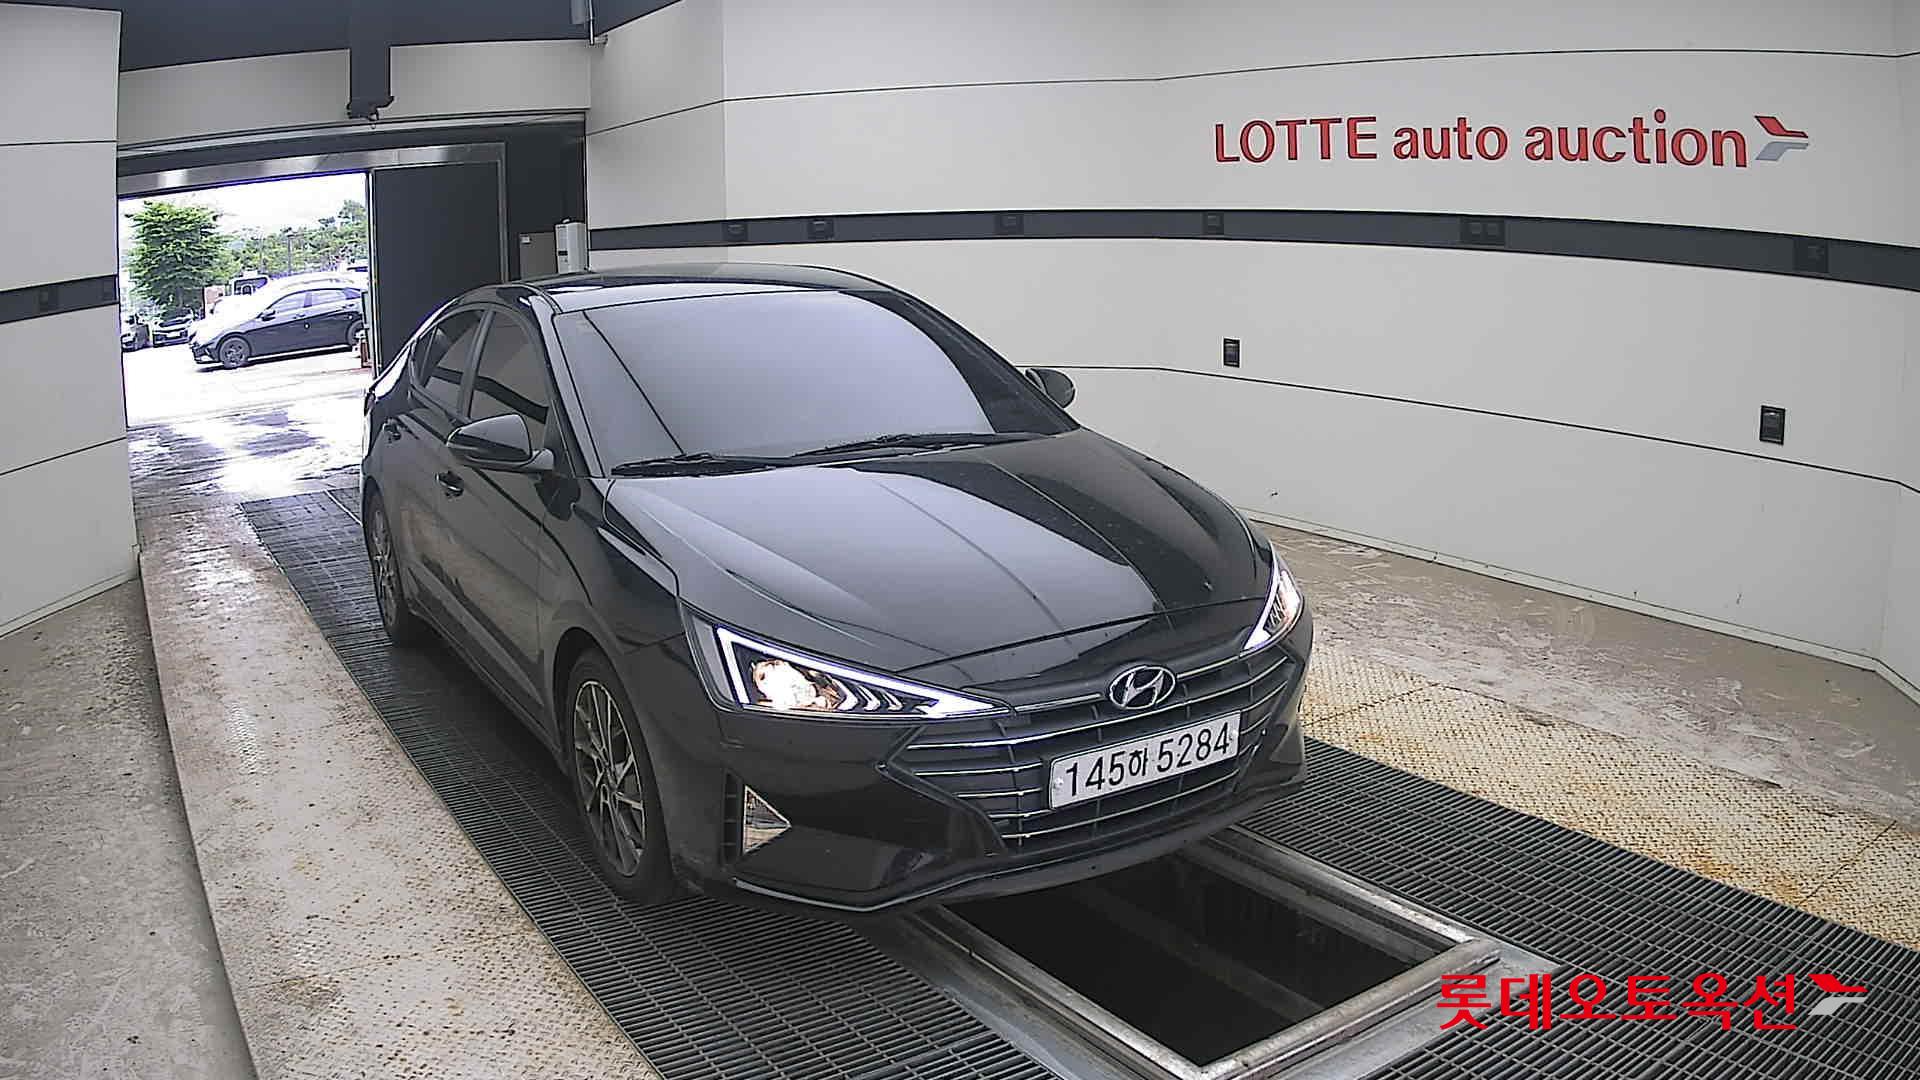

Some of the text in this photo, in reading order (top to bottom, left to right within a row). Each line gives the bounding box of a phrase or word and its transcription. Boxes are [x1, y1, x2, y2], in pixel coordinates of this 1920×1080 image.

[1215, 109, 1748, 168] LOTTE auto auction
[1065, 722, 1229, 796] 145하 5284
